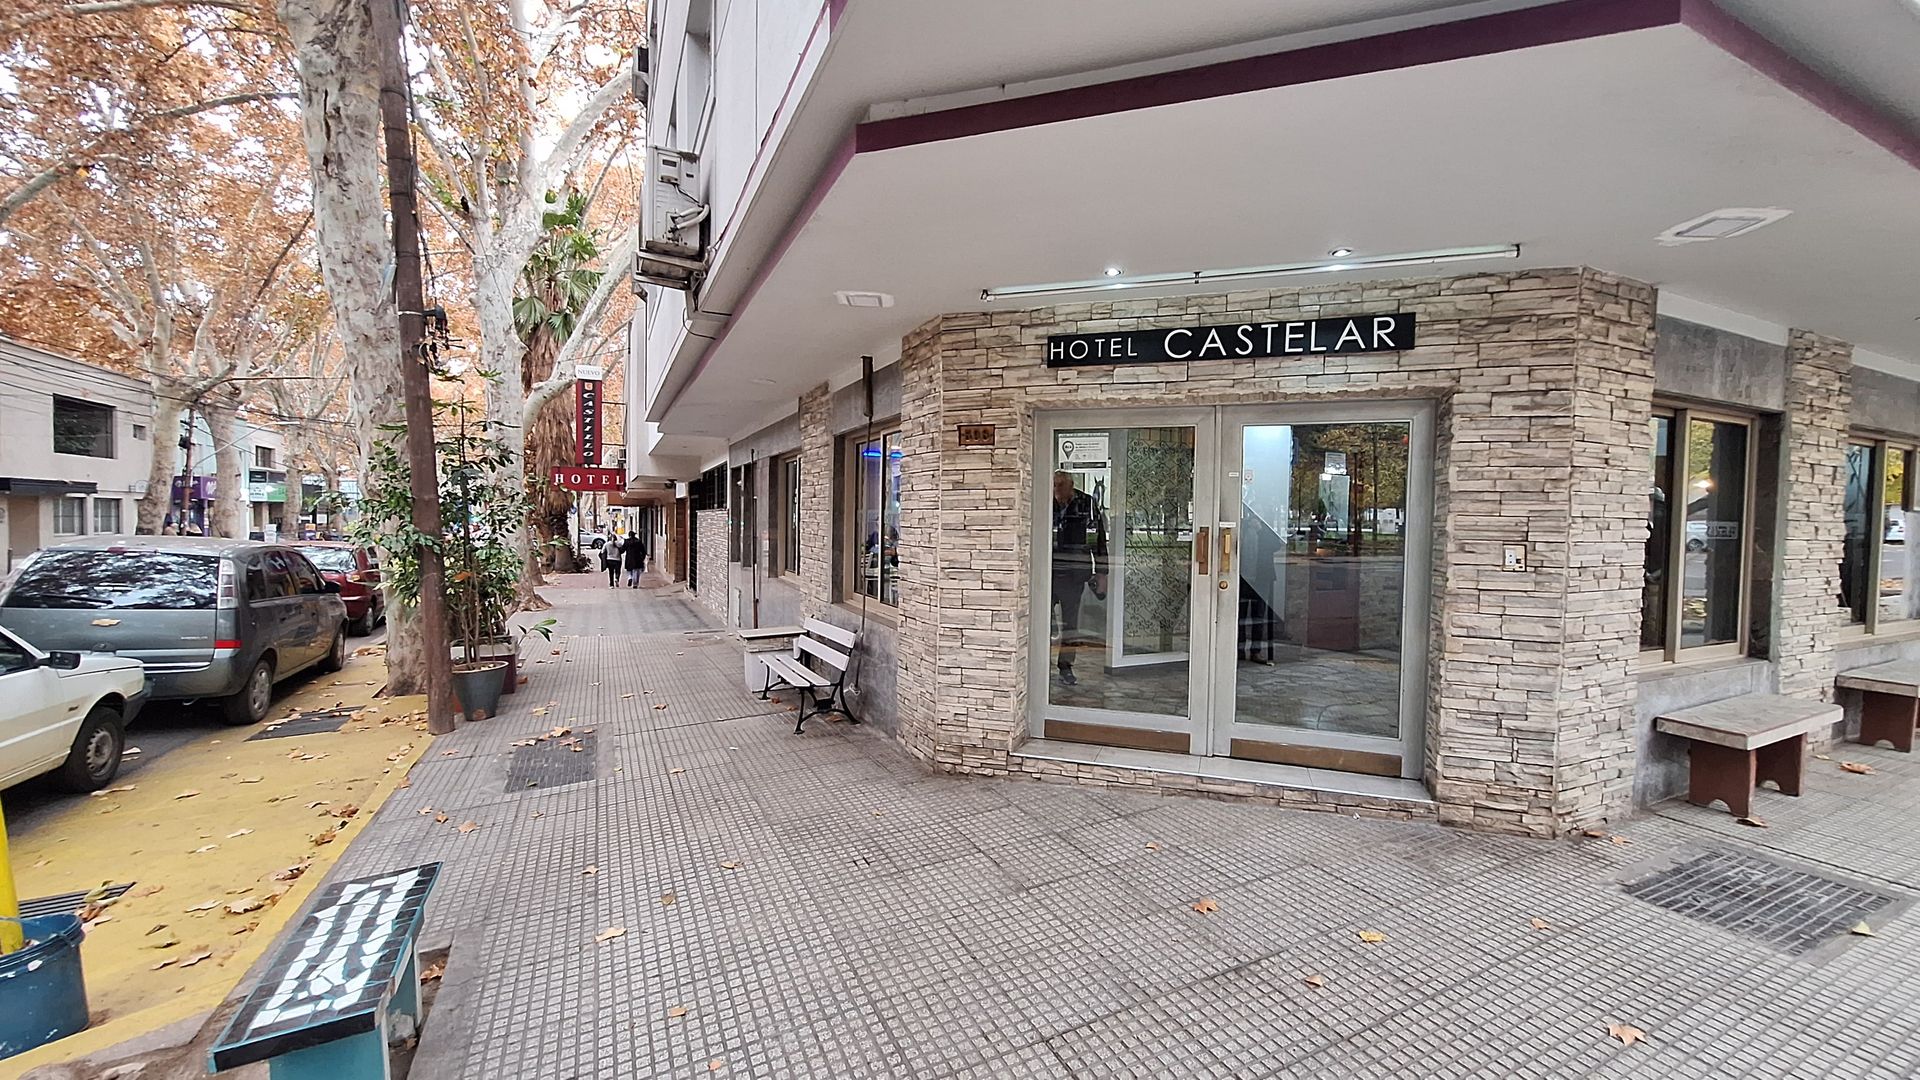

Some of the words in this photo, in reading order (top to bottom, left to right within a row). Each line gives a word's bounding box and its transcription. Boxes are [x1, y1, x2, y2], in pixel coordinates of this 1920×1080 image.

[1050, 337, 1138, 361] HOTEL
[1164, 317, 1396, 359] CASTELAR
[582, 392, 595, 457] CASTILLO
[555, 473, 624, 485] HOTEL
